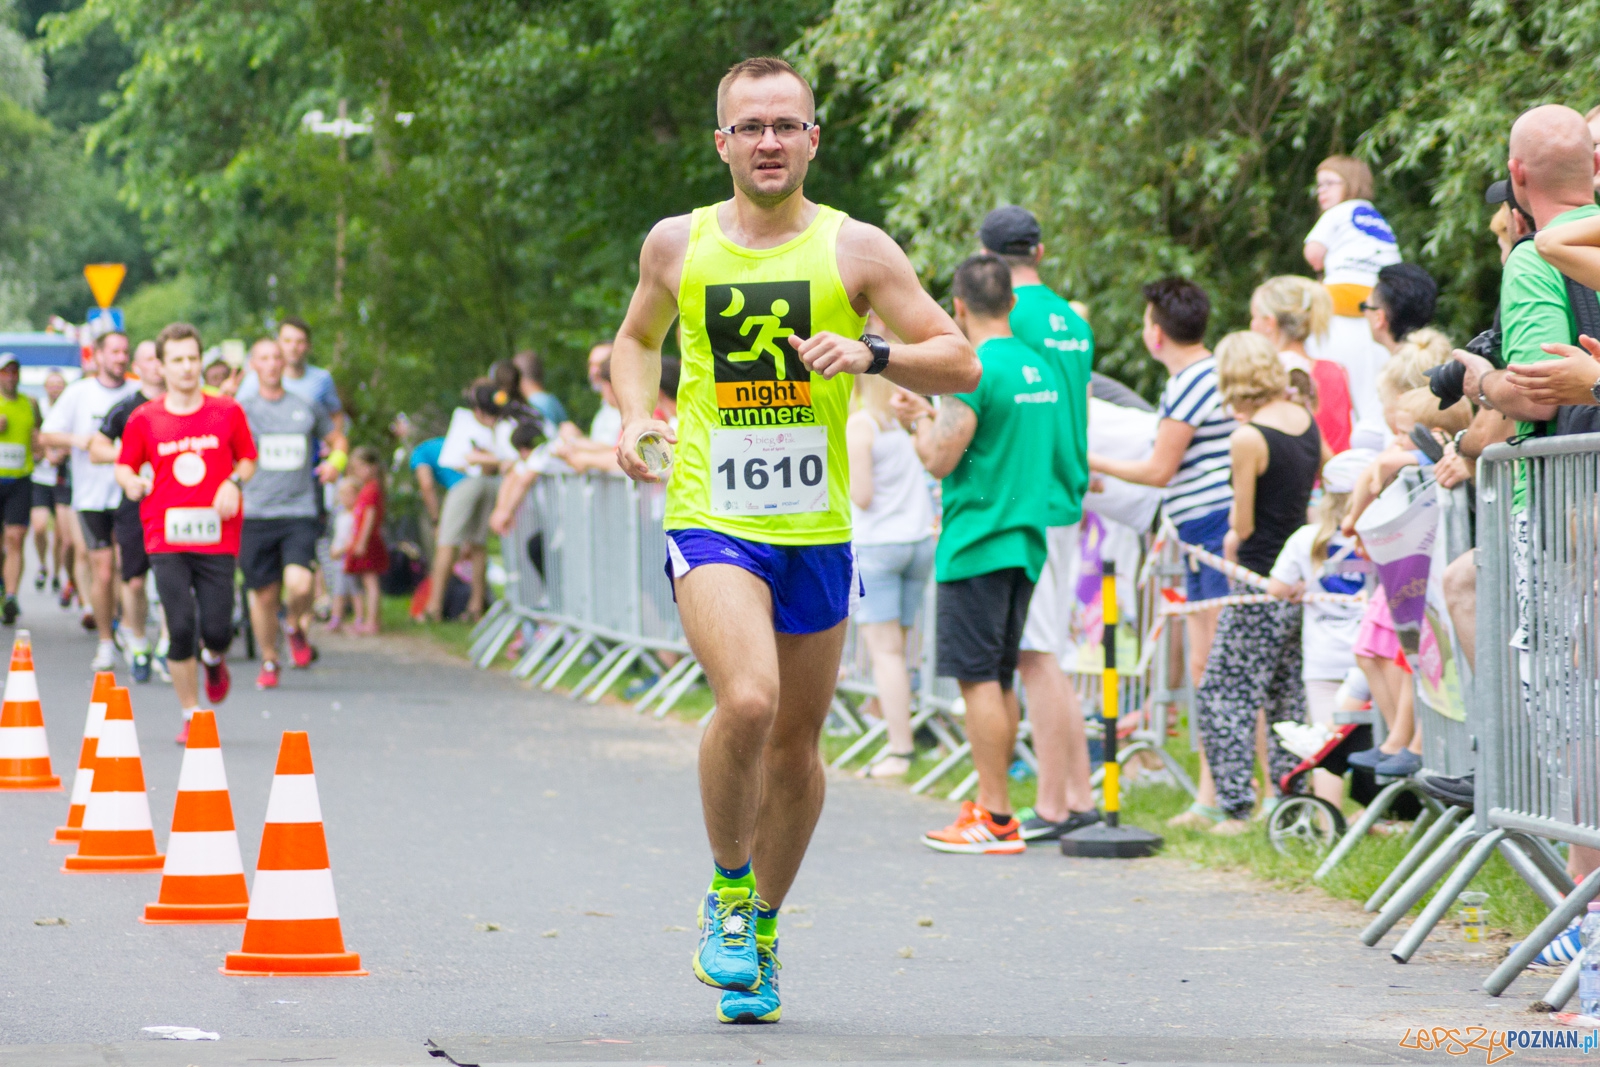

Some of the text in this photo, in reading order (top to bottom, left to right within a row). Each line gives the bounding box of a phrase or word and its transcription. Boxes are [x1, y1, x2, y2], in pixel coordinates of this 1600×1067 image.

[736, 382, 796, 405] night
[720, 407, 814, 425] runners
[743, 434, 776, 453] 5 bieg
[717, 454, 823, 490] 1610
